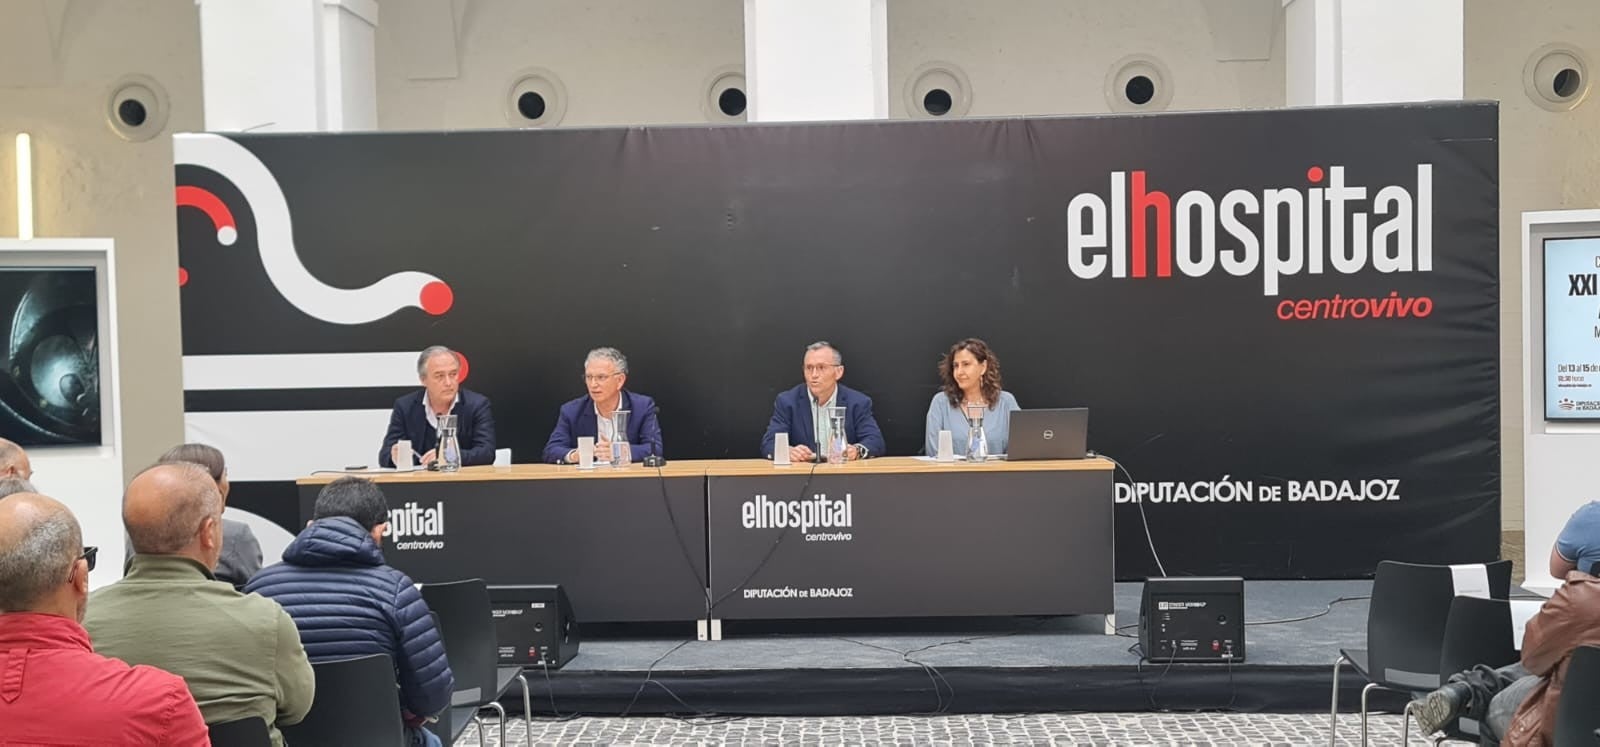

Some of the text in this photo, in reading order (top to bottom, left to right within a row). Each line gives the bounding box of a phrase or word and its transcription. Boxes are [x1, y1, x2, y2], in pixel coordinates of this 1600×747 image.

[1067, 164, 1432, 296] elhospital
[1568, 273, 1598, 296] XXI
[1276, 291, 1433, 321] centrovivo
[1114, 475, 1401, 504] DIPUTACIÓN DE BADAJOZ
[742, 493, 852, 534] elhospital
[397, 540, 444, 550] centrovivo
[806, 532, 852, 541] centrovivo
[743, 586, 853, 598] DIPUTACIÓN DE BADAJOZ
